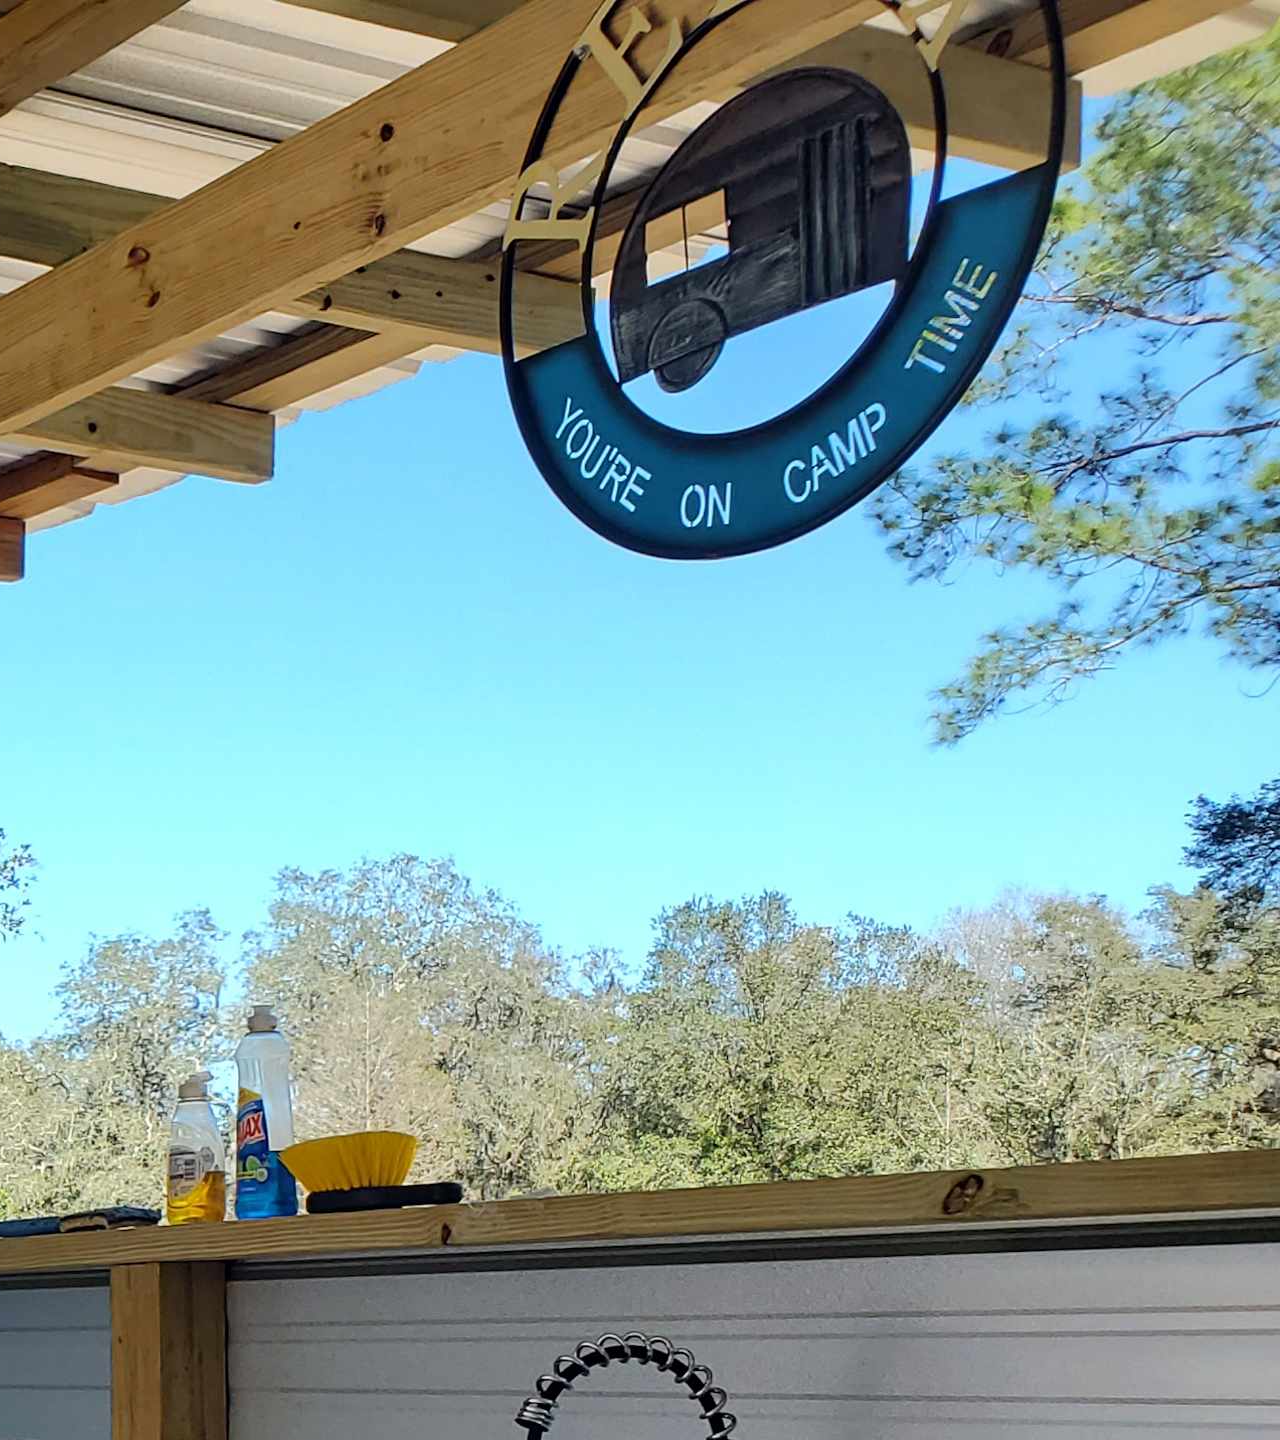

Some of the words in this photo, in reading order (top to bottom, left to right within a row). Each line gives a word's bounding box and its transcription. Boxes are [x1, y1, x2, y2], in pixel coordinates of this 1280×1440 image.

[554, 397, 652, 513] YOU'RE
[680, 482, 732, 528] ON
[783, 402, 887, 503] CAMP
[904, 258, 997, 373] TIME
